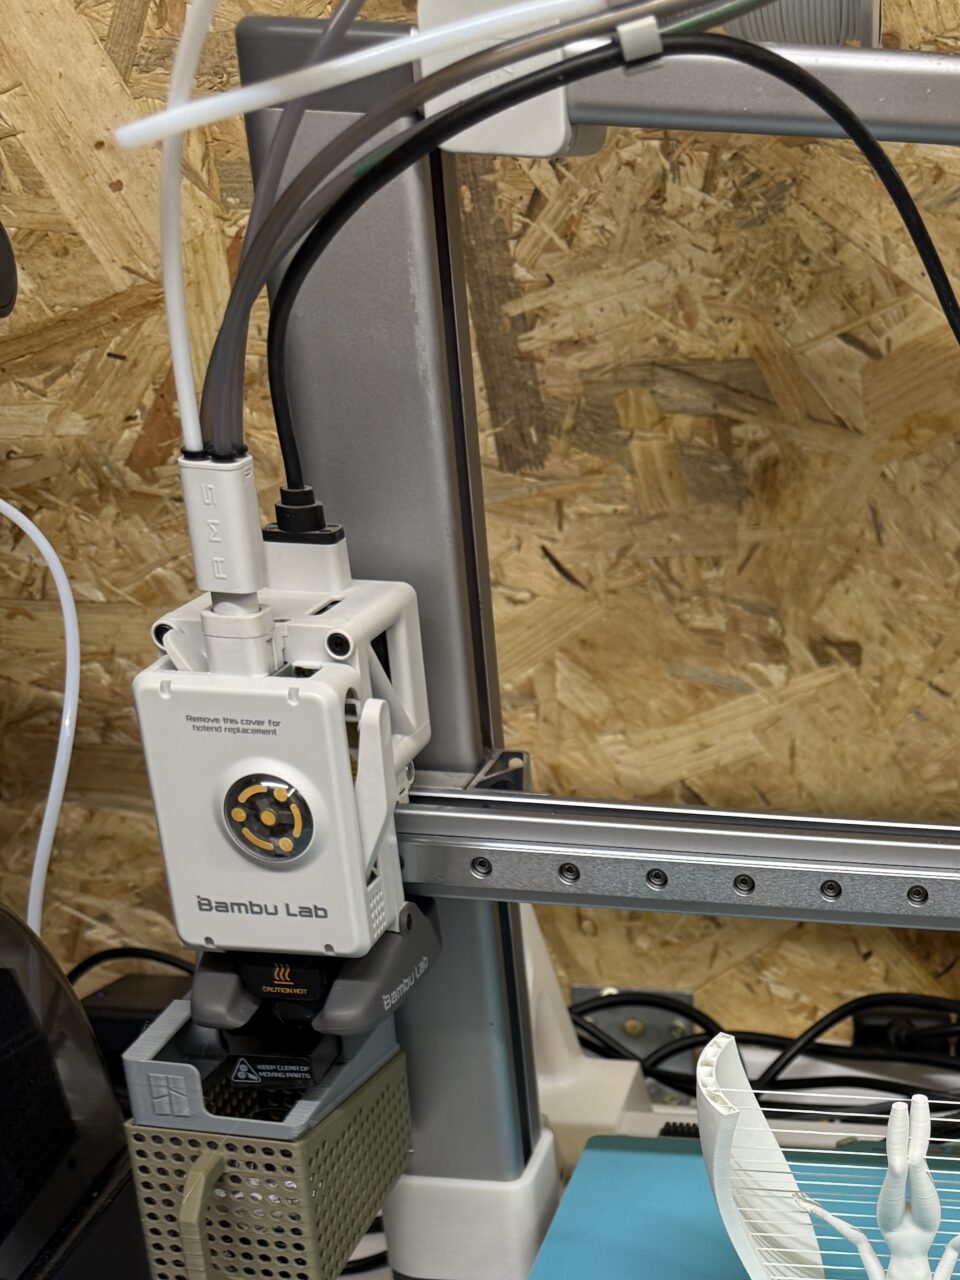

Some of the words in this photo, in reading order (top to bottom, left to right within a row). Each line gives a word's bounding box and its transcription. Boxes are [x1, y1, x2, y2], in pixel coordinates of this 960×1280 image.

[201, 483, 227, 579] AMS
[185, 714, 220, 724] Remove
[222, 716, 239, 725] this
[267, 719, 281, 727] for
[192, 724, 222, 733] hotend
[223, 726, 277, 736] replacement
[196, 895, 279, 916] Bambu
[285, 903, 328, 919] Lab
[262, 985, 293, 995] CAUTION
[382, 972, 415, 1011] Bambu
[413, 956, 429, 979] Lab
